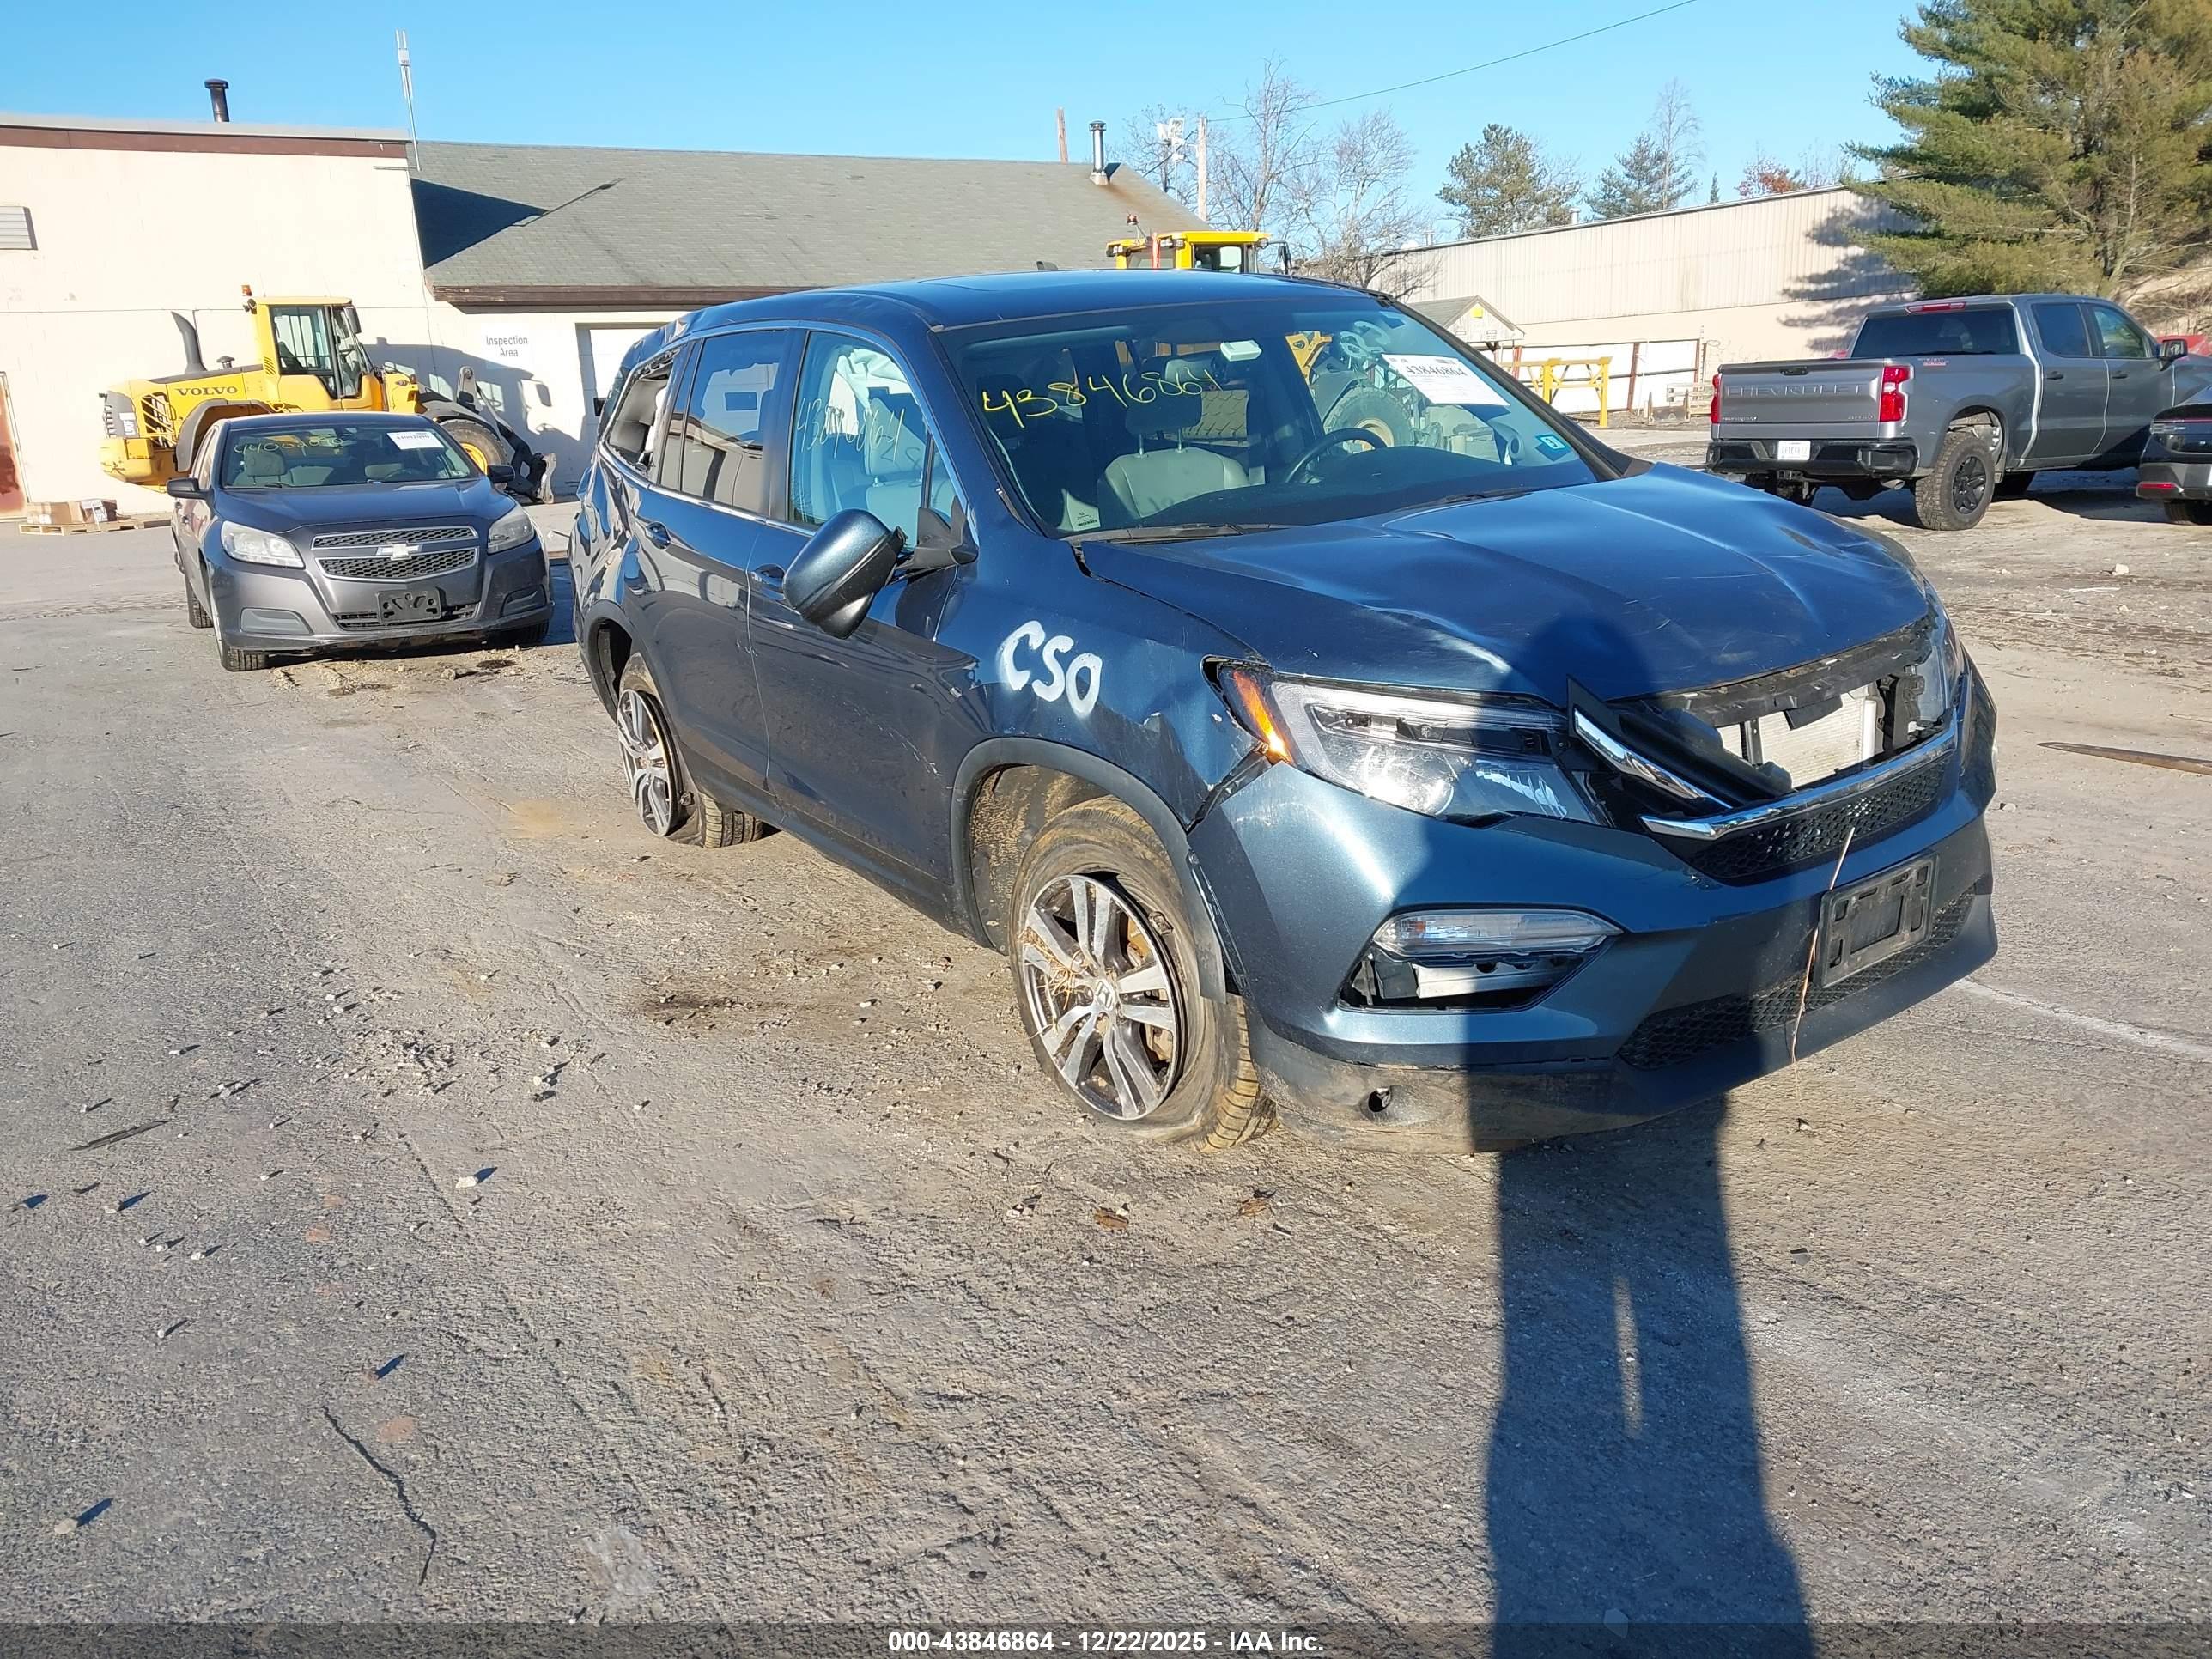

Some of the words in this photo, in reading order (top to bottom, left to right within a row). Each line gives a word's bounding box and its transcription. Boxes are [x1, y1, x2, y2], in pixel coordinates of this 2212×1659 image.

[486, 335, 528, 346] Inspection
[500, 348, 519, 357] Area
[177, 386, 239, 397] VOLVO
[1726, 383, 1862, 398] CHEVROLET
[982, 366, 1223, 428] 43846864
